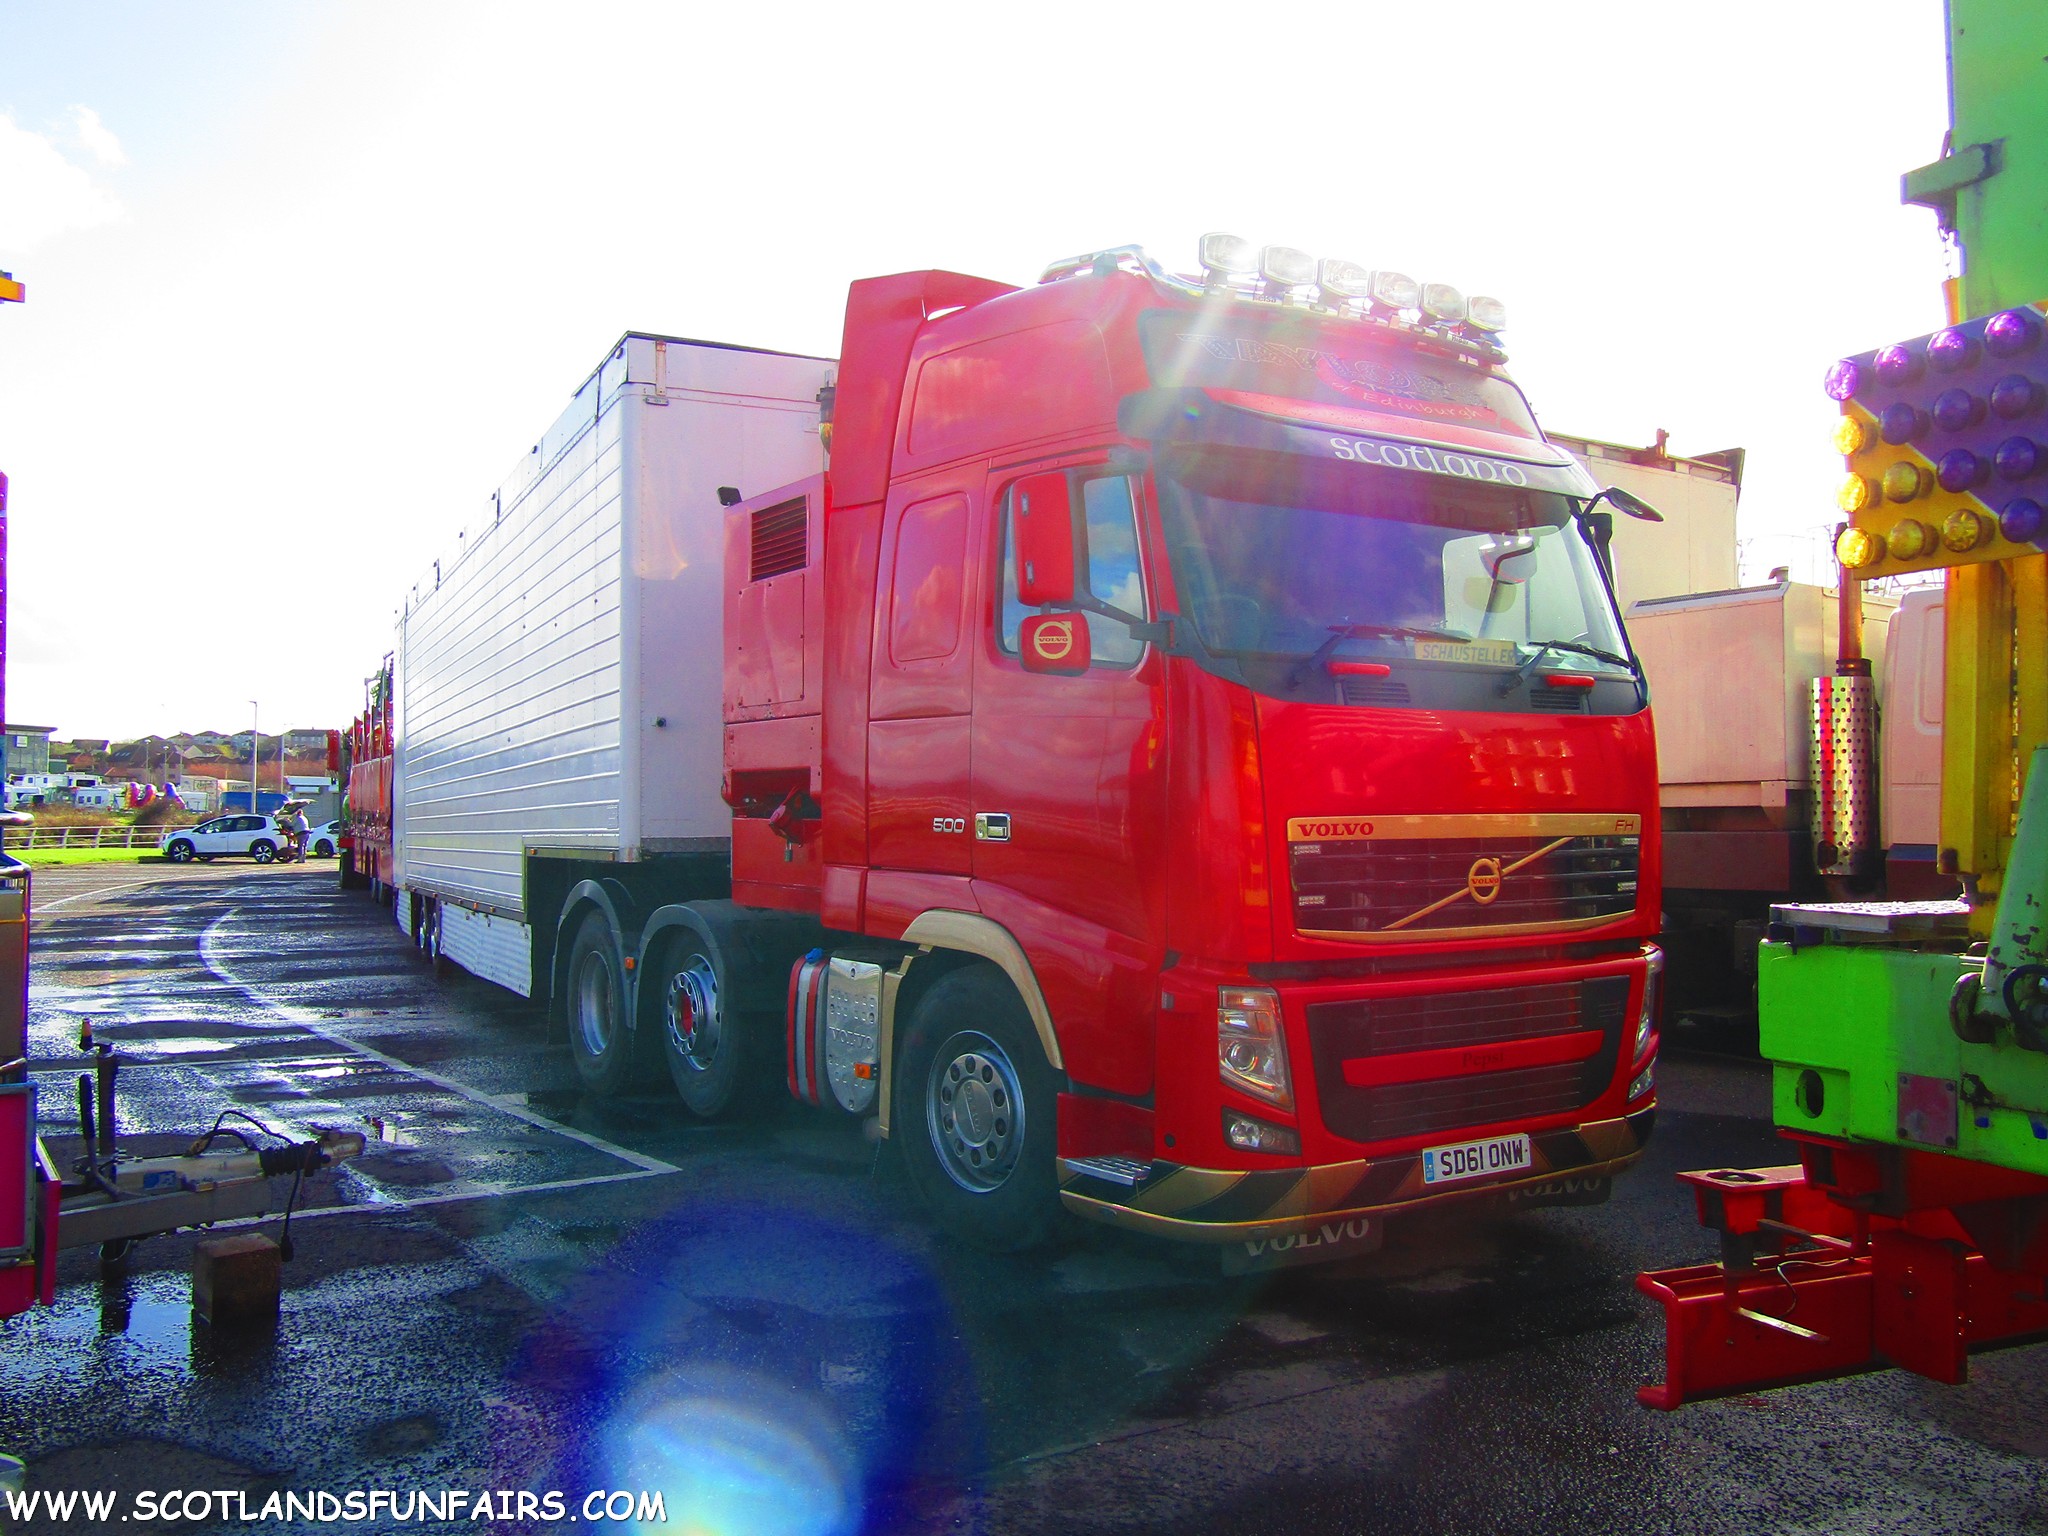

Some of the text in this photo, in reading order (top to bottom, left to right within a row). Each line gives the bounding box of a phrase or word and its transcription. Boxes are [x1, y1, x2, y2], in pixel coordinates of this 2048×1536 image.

[1362, 391, 1484, 421] Edinburgh
[1422, 643, 1515, 665] SCHAUSTELLER
[932, 817, 966, 833] 500
[1297, 822, 1374, 837] VOLVO
[1614, 819, 1635, 832] FH
[1471, 877, 1500, 885] VOLVO
[1440, 1138, 1524, 1177] SD61 ONW
[1244, 1218, 1370, 1257] VOLVO
